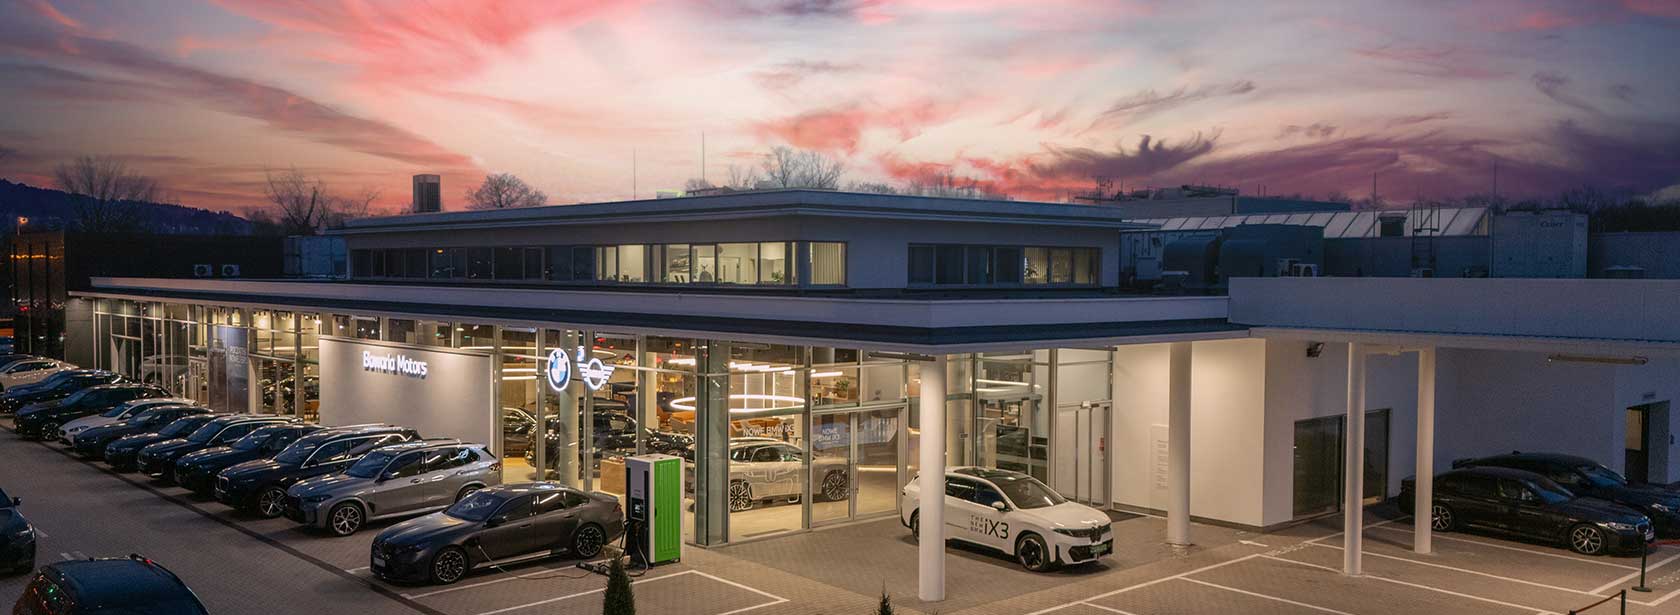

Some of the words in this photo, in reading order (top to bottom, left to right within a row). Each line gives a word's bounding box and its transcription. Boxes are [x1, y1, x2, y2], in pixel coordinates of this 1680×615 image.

[363, 351, 395, 371] Bawaria
[397, 354, 427, 376] Motors
[743, 427, 765, 438] NOWE
[767, 424, 784, 434] BMW
[984, 518, 1009, 539] iX3
